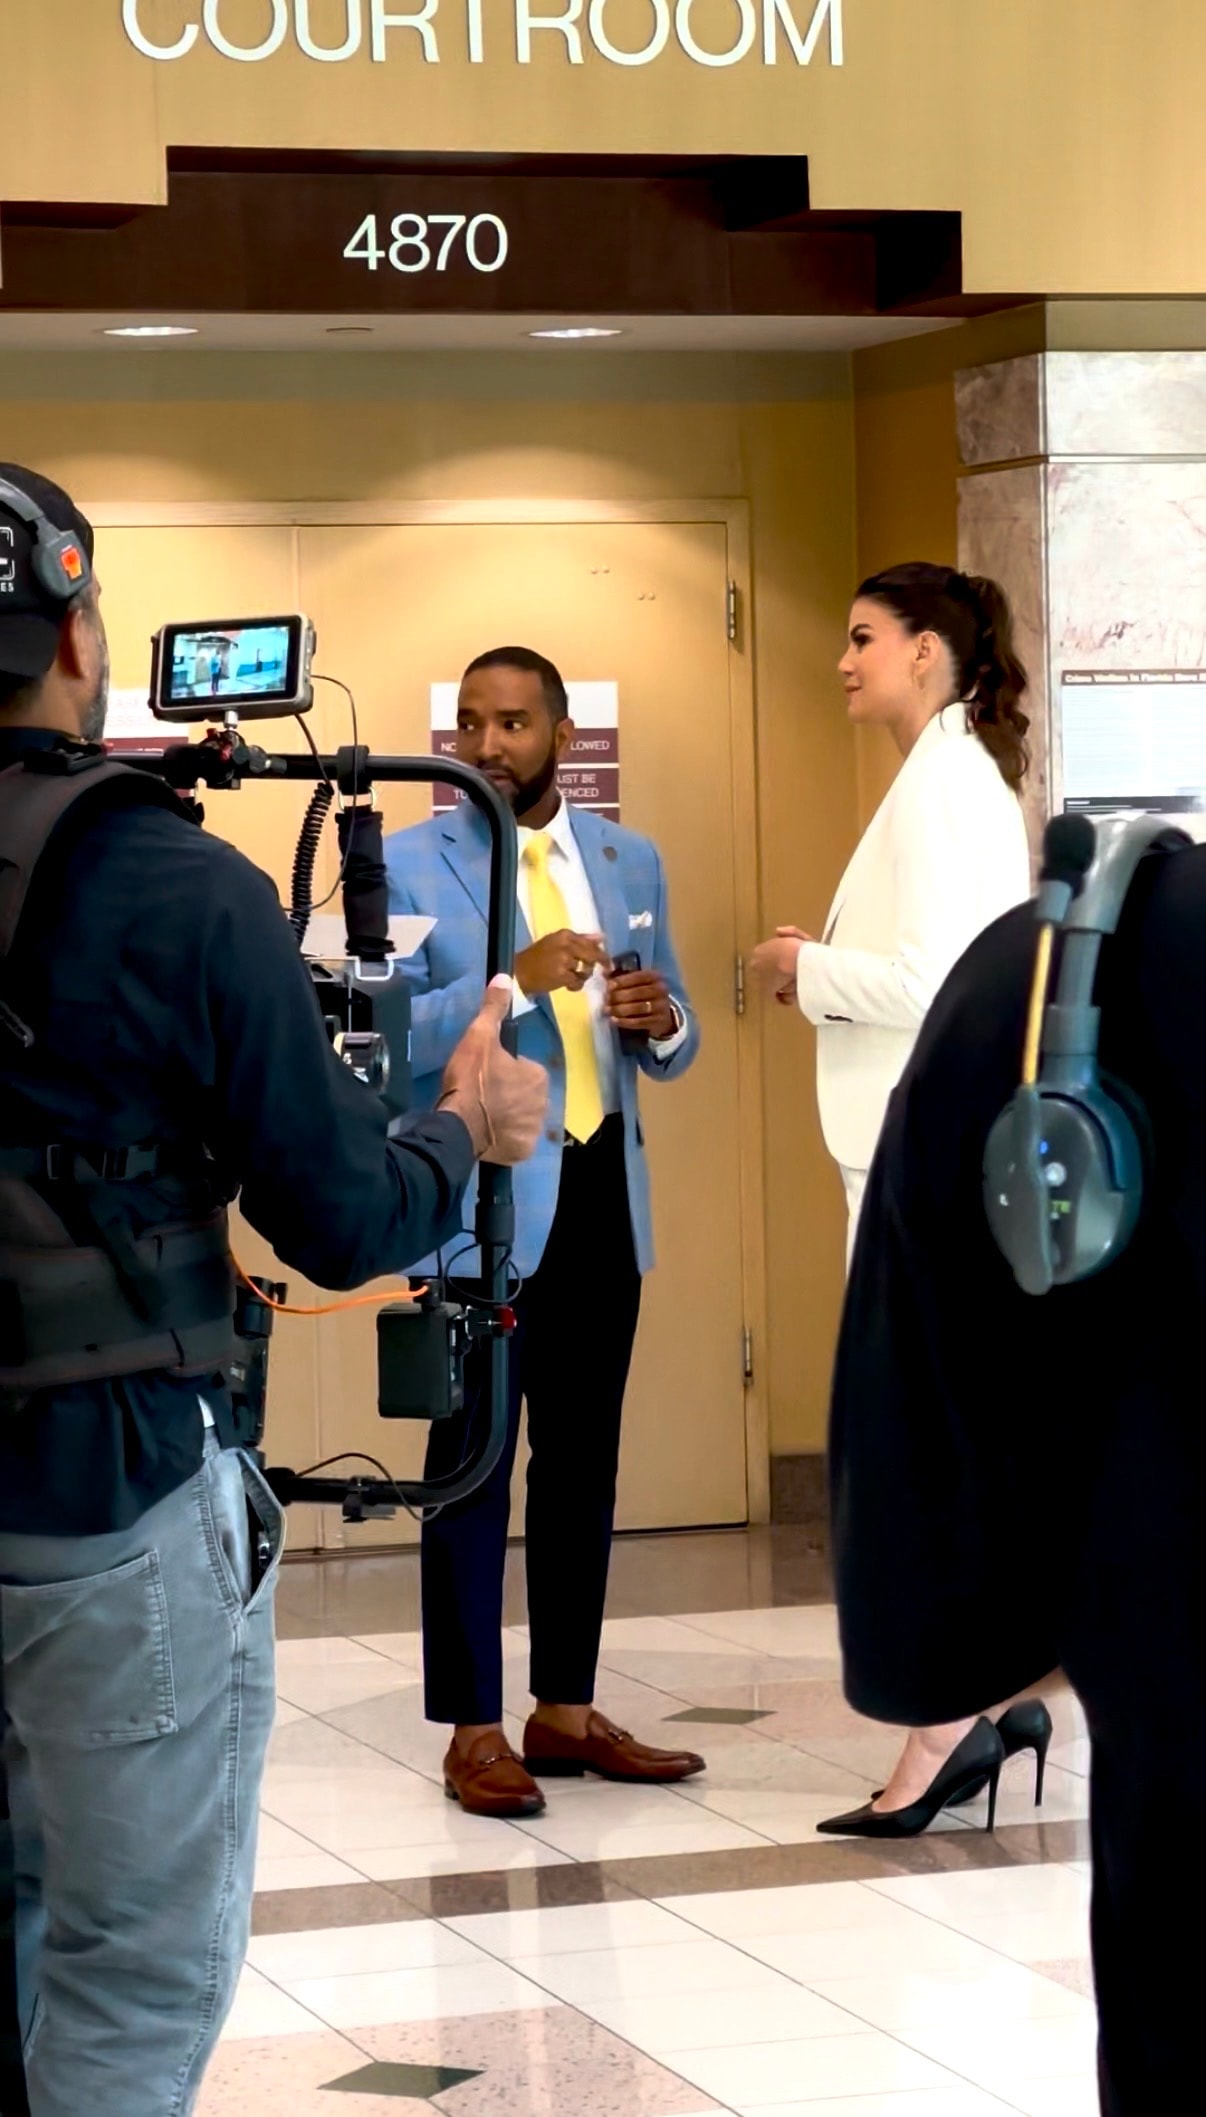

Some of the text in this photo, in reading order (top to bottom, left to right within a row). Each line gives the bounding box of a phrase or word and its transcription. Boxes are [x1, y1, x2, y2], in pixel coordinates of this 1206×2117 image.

[343, 213, 508, 272] 4870
[570, 740, 610, 751] LOWED
[557, 773, 596, 784] UST BE
[561, 787, 599, 797] ENCED
